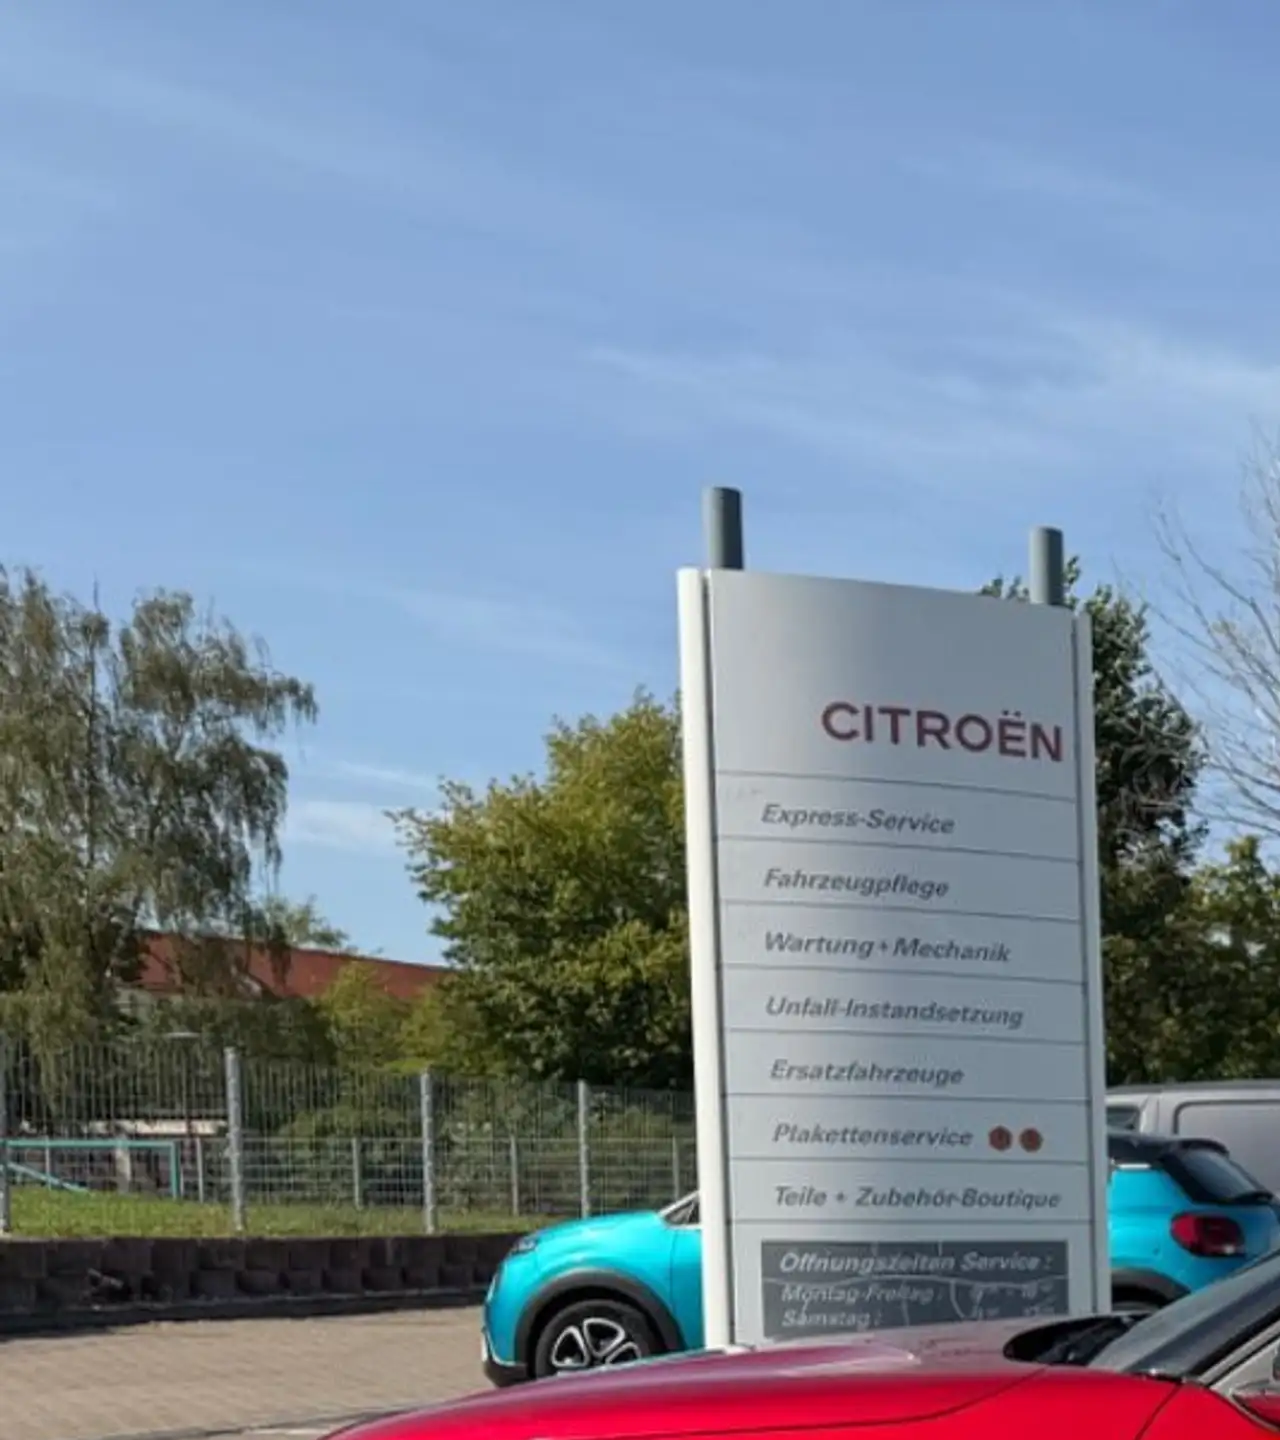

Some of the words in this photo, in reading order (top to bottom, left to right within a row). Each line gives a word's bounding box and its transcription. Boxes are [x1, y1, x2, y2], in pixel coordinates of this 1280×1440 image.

[821, 701, 1063, 763] CITROËN
[761, 803, 955, 834] Express-Service
[764, 867, 950, 899] Fahrzeugpflege
[765, 931, 874, 959] Wartung
[892, 936, 1012, 963] Mechanik
[765, 996, 1025, 1029] Unfall-Instandsetzung
[770, 1058, 966, 1088] Ersatzfahrzeuge
[772, 1122, 975, 1147] Plakettenservice
[775, 1185, 828, 1208] Teile
[855, 1185, 1063, 1212] Zubehör-Boutique
